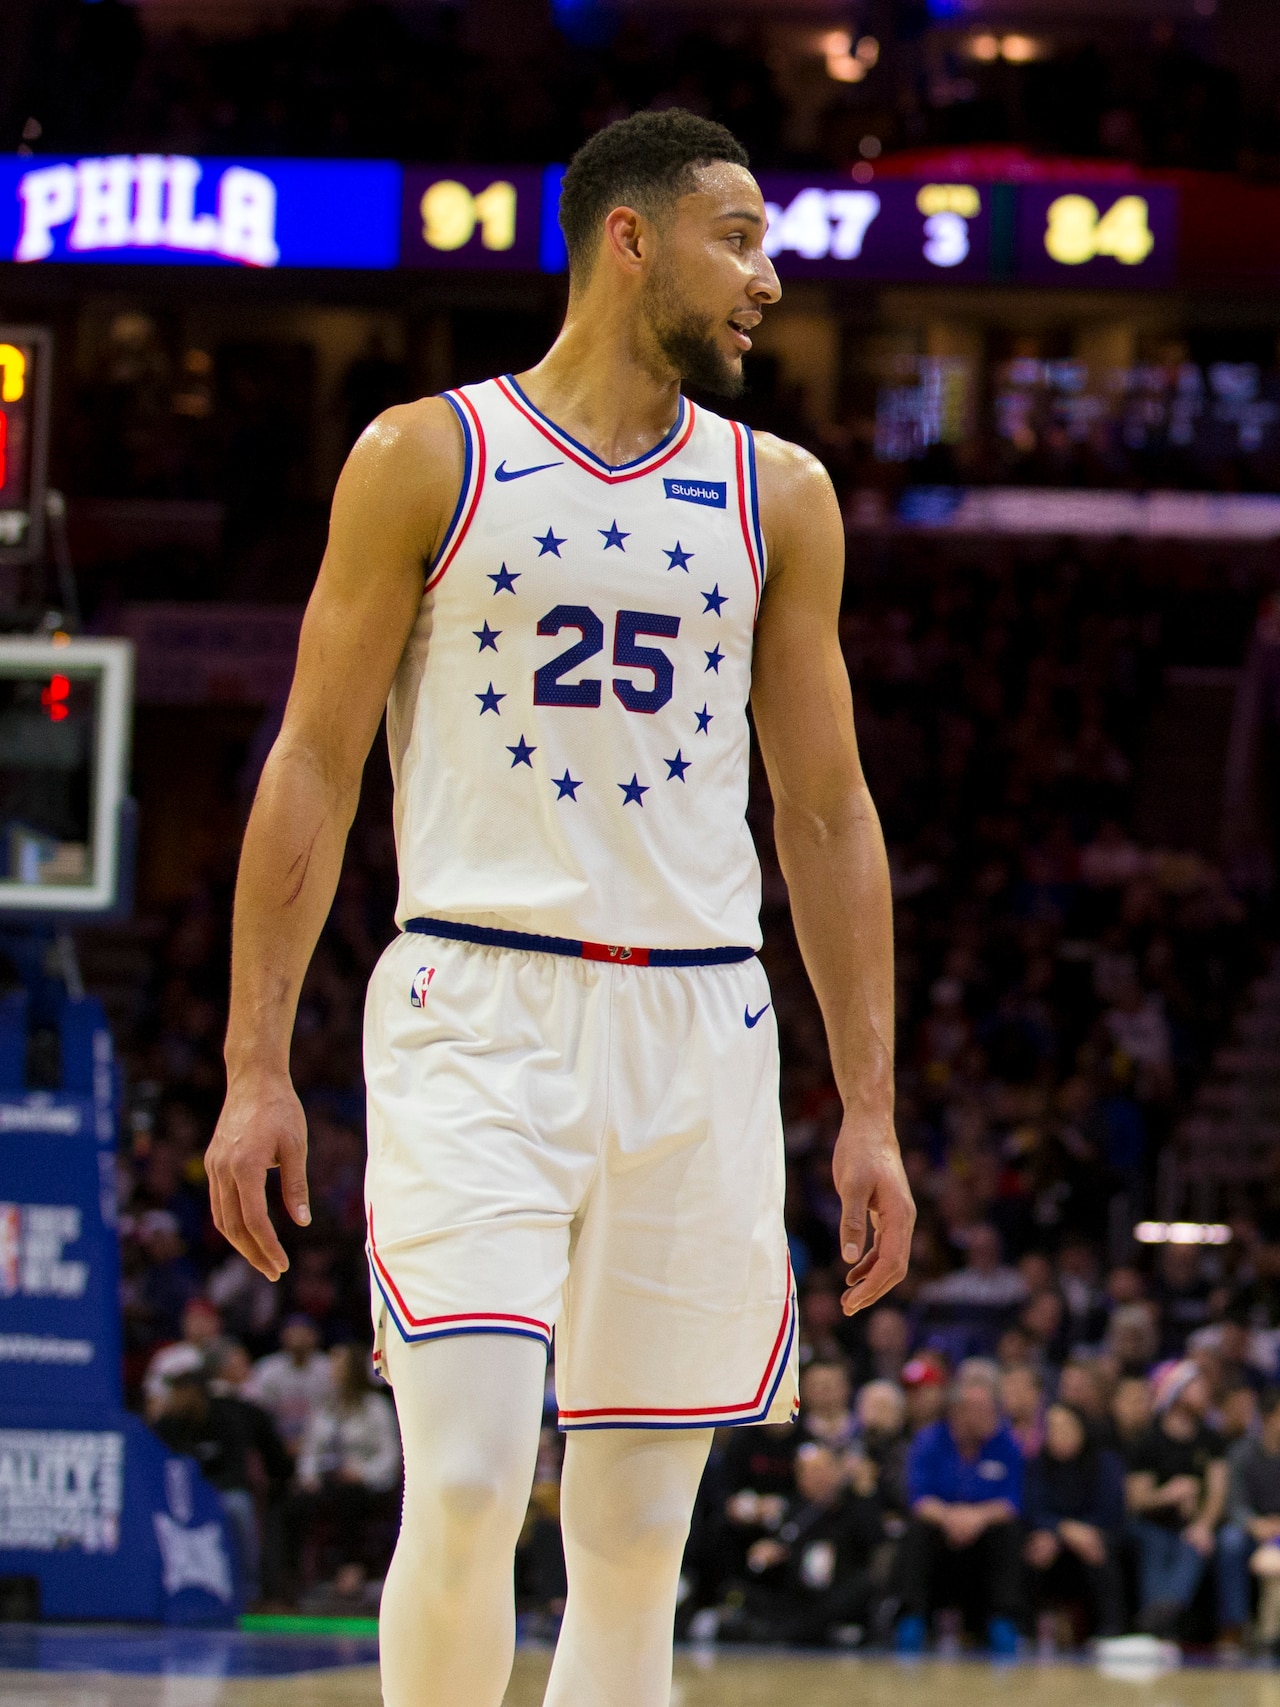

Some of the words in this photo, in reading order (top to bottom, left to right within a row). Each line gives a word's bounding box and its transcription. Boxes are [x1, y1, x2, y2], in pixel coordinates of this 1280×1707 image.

[15, 154, 281, 269] PHILA
[420, 180, 517, 252] 91
[922, 211, 971, 267] 3
[1044, 194, 1155, 265] 84
[671, 483, 720, 500] StubHub
[533, 604, 682, 715] 25
